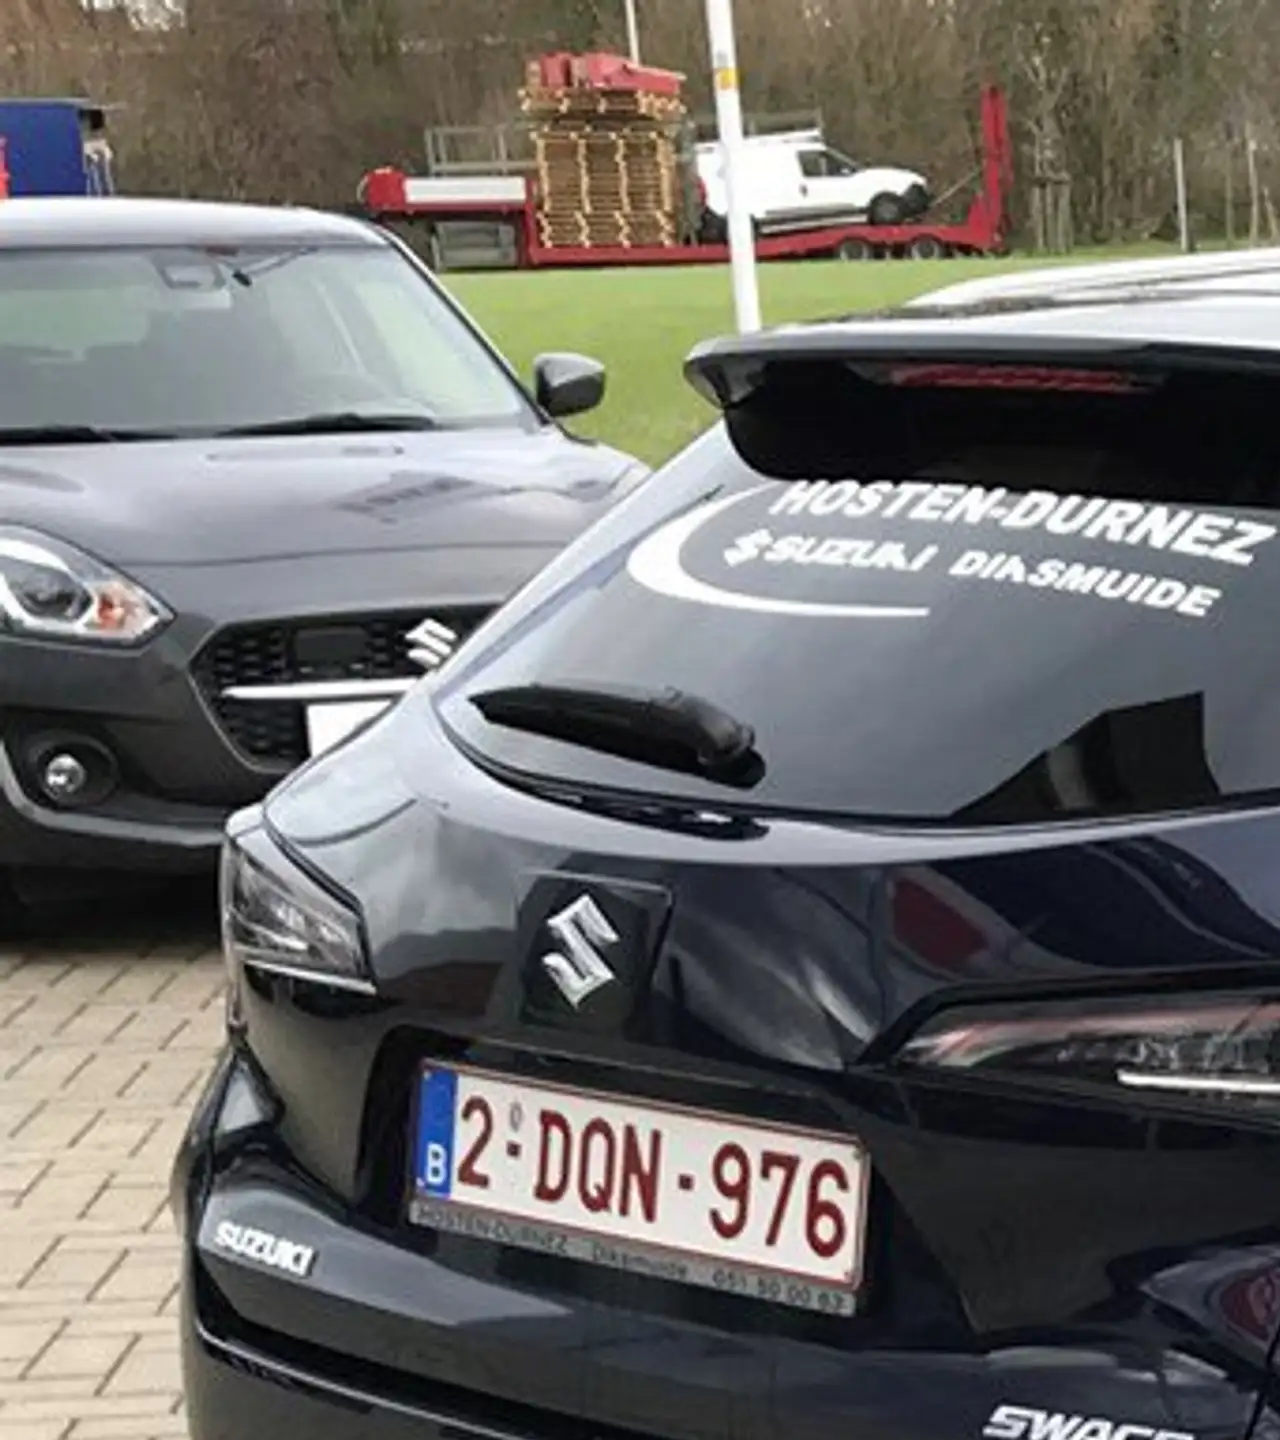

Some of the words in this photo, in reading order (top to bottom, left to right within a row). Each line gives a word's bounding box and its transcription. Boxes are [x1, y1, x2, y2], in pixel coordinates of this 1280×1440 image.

[769, 479, 1278, 566] HOSTEN-DURNEZ
[426, 1144, 448, 1184] B
[214, 1220, 314, 1276] SUZUKI
